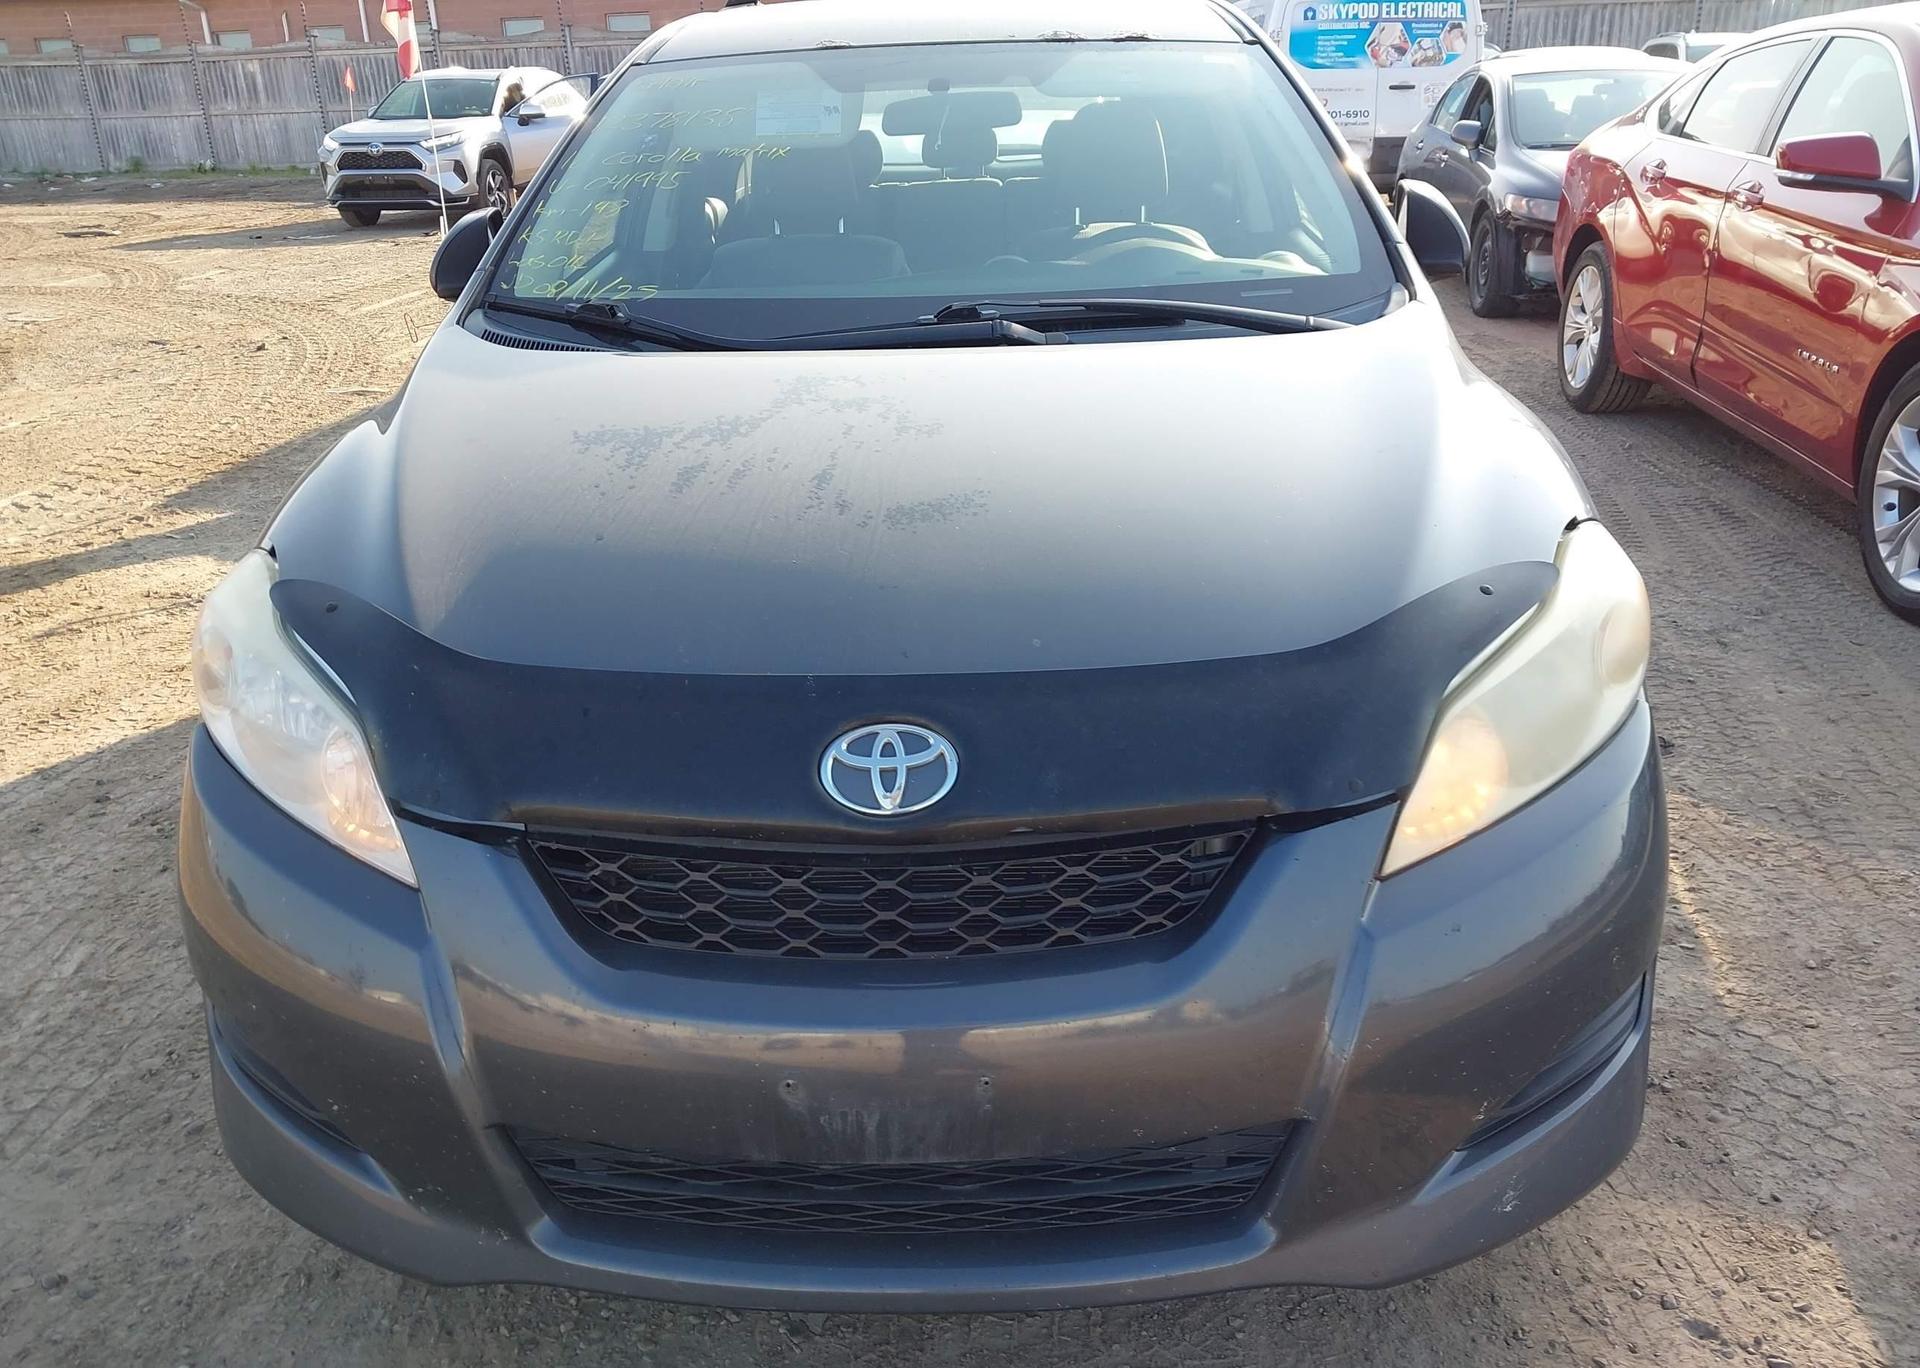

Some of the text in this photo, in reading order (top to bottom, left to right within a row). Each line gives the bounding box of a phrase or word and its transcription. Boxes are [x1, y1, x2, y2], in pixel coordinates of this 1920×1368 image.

[1319, 1, 1464, 19] SKYPOD ELECTRICAL
[1797, 348, 1840, 375] IMPALA
